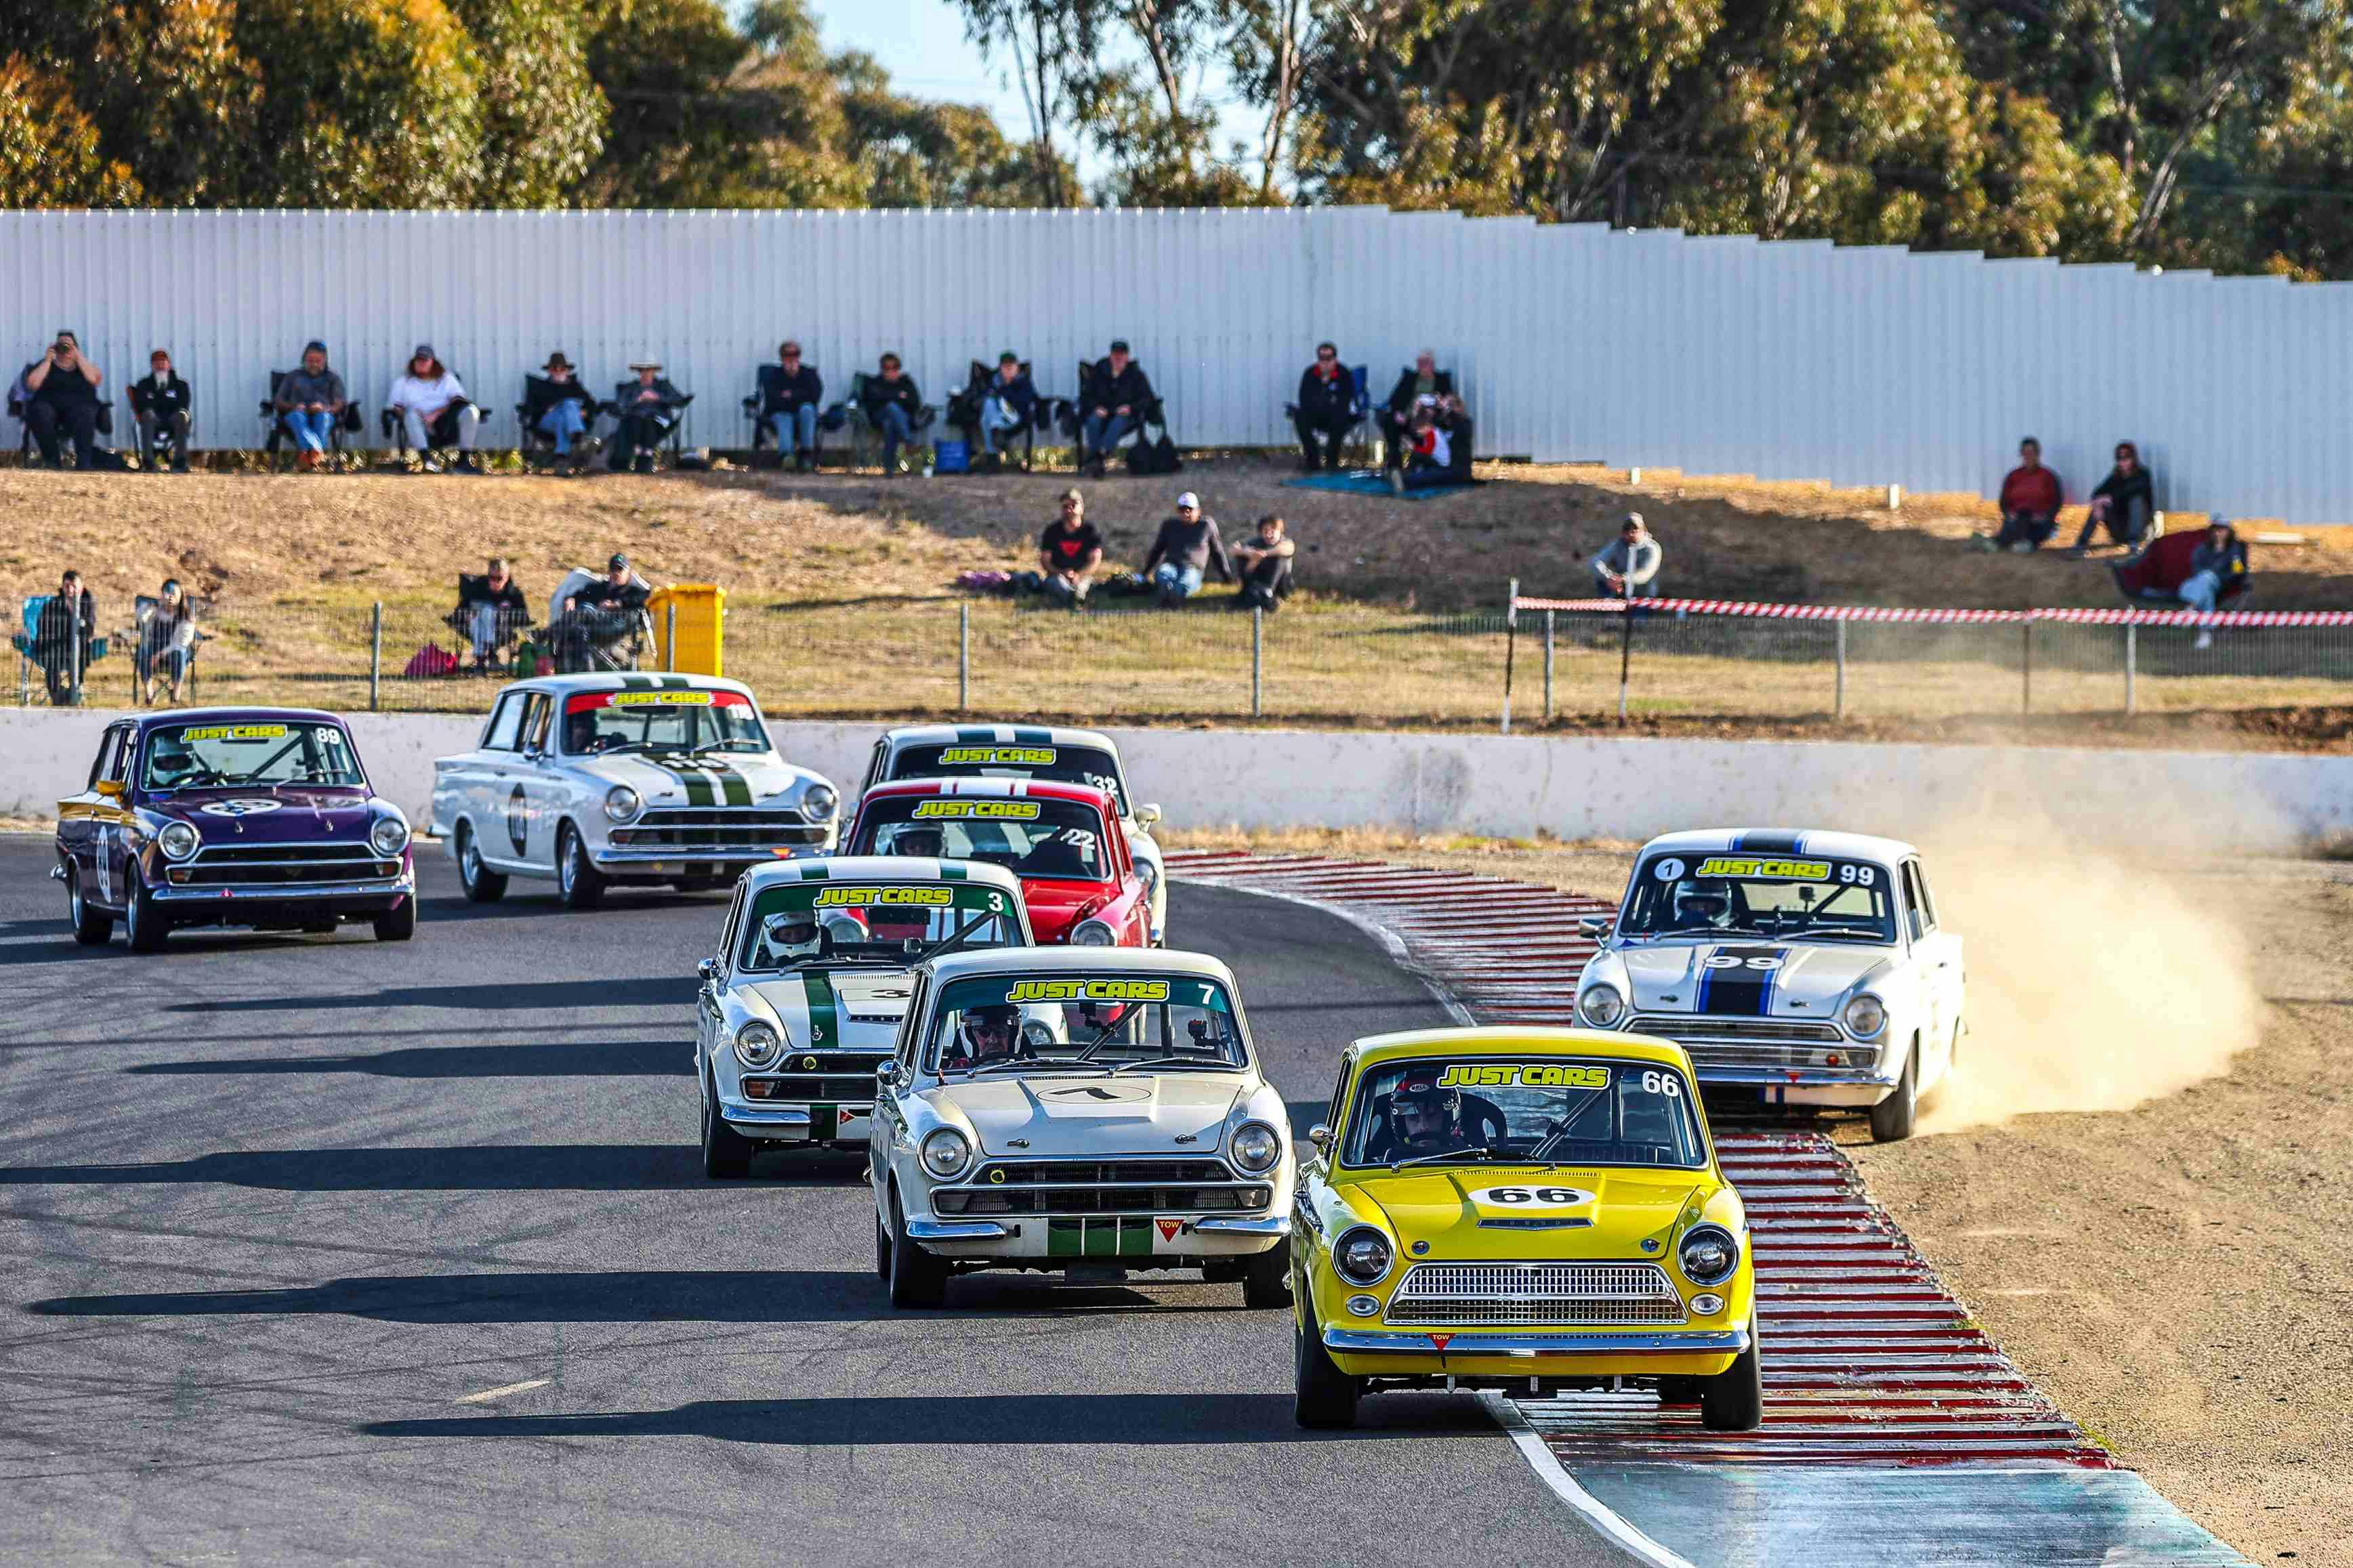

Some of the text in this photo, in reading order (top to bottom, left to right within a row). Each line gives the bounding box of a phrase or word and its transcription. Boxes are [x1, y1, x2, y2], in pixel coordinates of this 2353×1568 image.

[184, 725, 286, 741] JUST CARS
[315, 727, 339, 744] 89
[942, 748, 1054, 763] JUST CARS
[1093, 775, 1119, 794] 32
[917, 802, 1037, 818] JUST CARS
[1067, 828, 1095, 850] 22
[1664, 862, 1673, 876] 1
[1699, 860, 1829, 878] JUST CARS
[1840, 864, 1874, 886] 99
[817, 888, 951, 905] JUST CARS
[988, 891, 1003, 911] 3
[1705, 956, 1784, 970] 99
[870, 989, 911, 998] 3
[1009, 981, 1167, 1000] JUST CARS
[1198, 983, 1215, 1004] 7
[1440, 1066, 1608, 1087] JUST CARS
[1642, 1071, 1679, 1097] 66
[1488, 1188, 1581, 1203] 66
